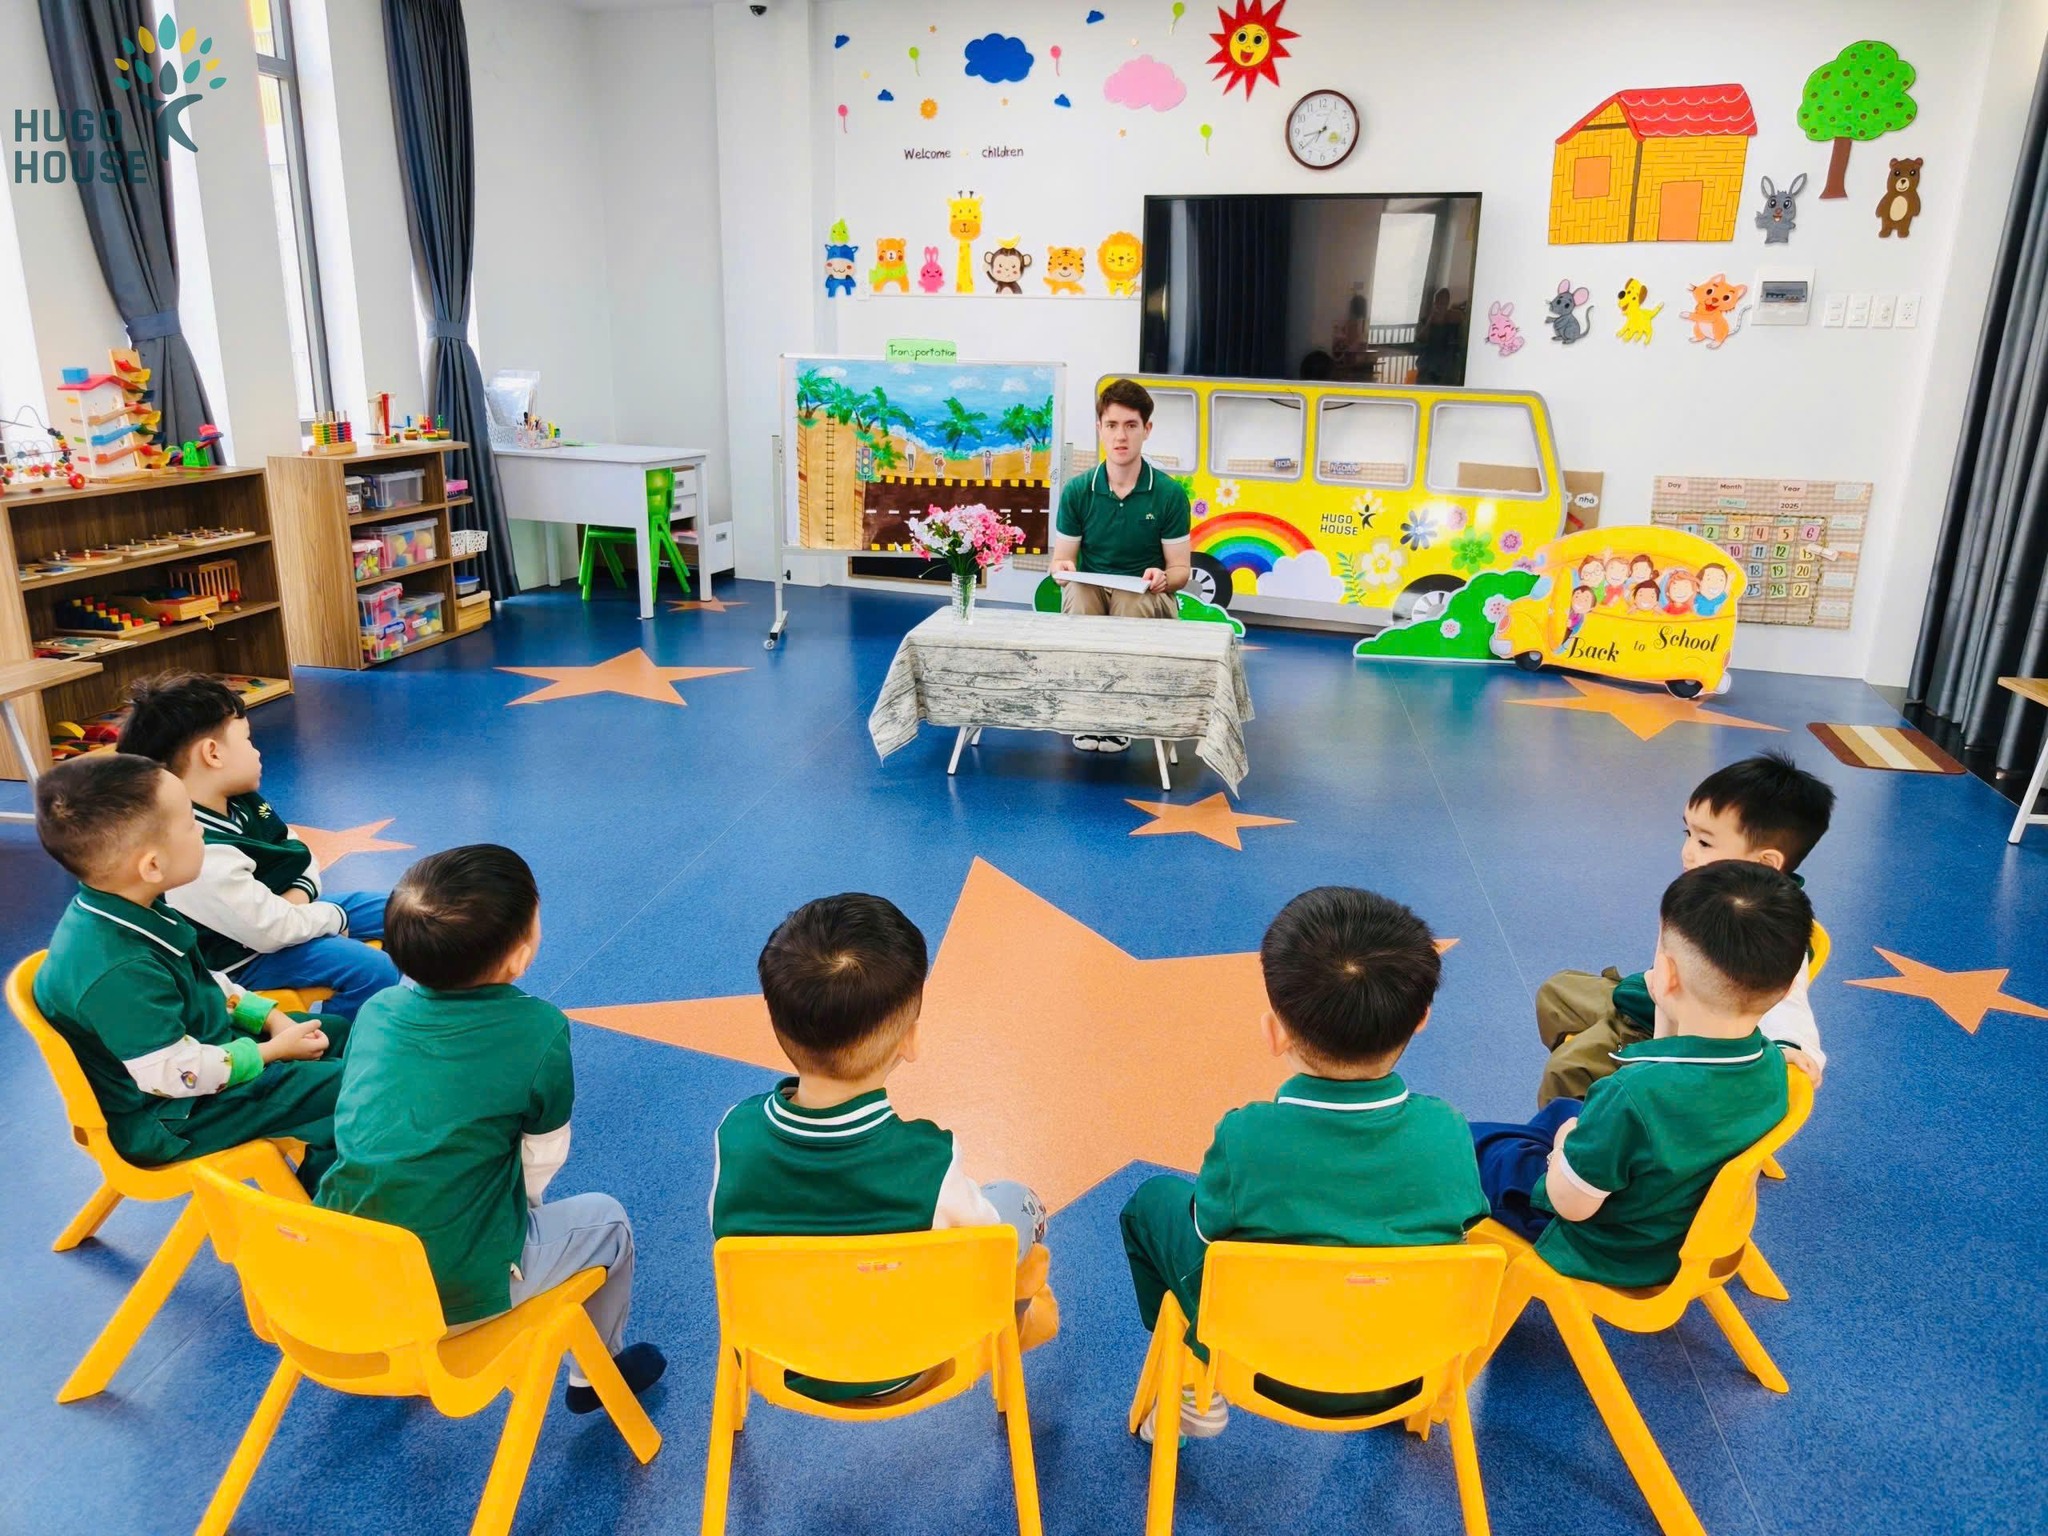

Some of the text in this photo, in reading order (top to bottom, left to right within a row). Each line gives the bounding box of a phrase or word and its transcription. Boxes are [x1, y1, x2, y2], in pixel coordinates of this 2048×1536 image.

[1307, 103, 1313, 113] 11
[1319, 98, 1328, 108] 12
[1298, 114, 1306, 123] 10
[904, 146, 1024, 160] Welcome children
[889, 344, 957, 361] Transportation
[1321, 513, 1353, 524] HUGO
[1320, 524, 1358, 536] HOUSE
[1706, 526, 1715, 538] 2
[1733, 526, 1740, 538] 3
[1756, 527, 1765, 539] 4
[1782, 528, 1789, 540] 5
[1806, 527, 1815, 538] 6
[1729, 546, 1740, 557] 10
[1755, 546, 1764, 557] 11
[1775, 545, 1786, 557] 12
[1750, 564, 1809, 576] 18 19 20
[1747, 584, 1808, 596] 25 26 27
[1562, 624, 1720, 662] Back to School
